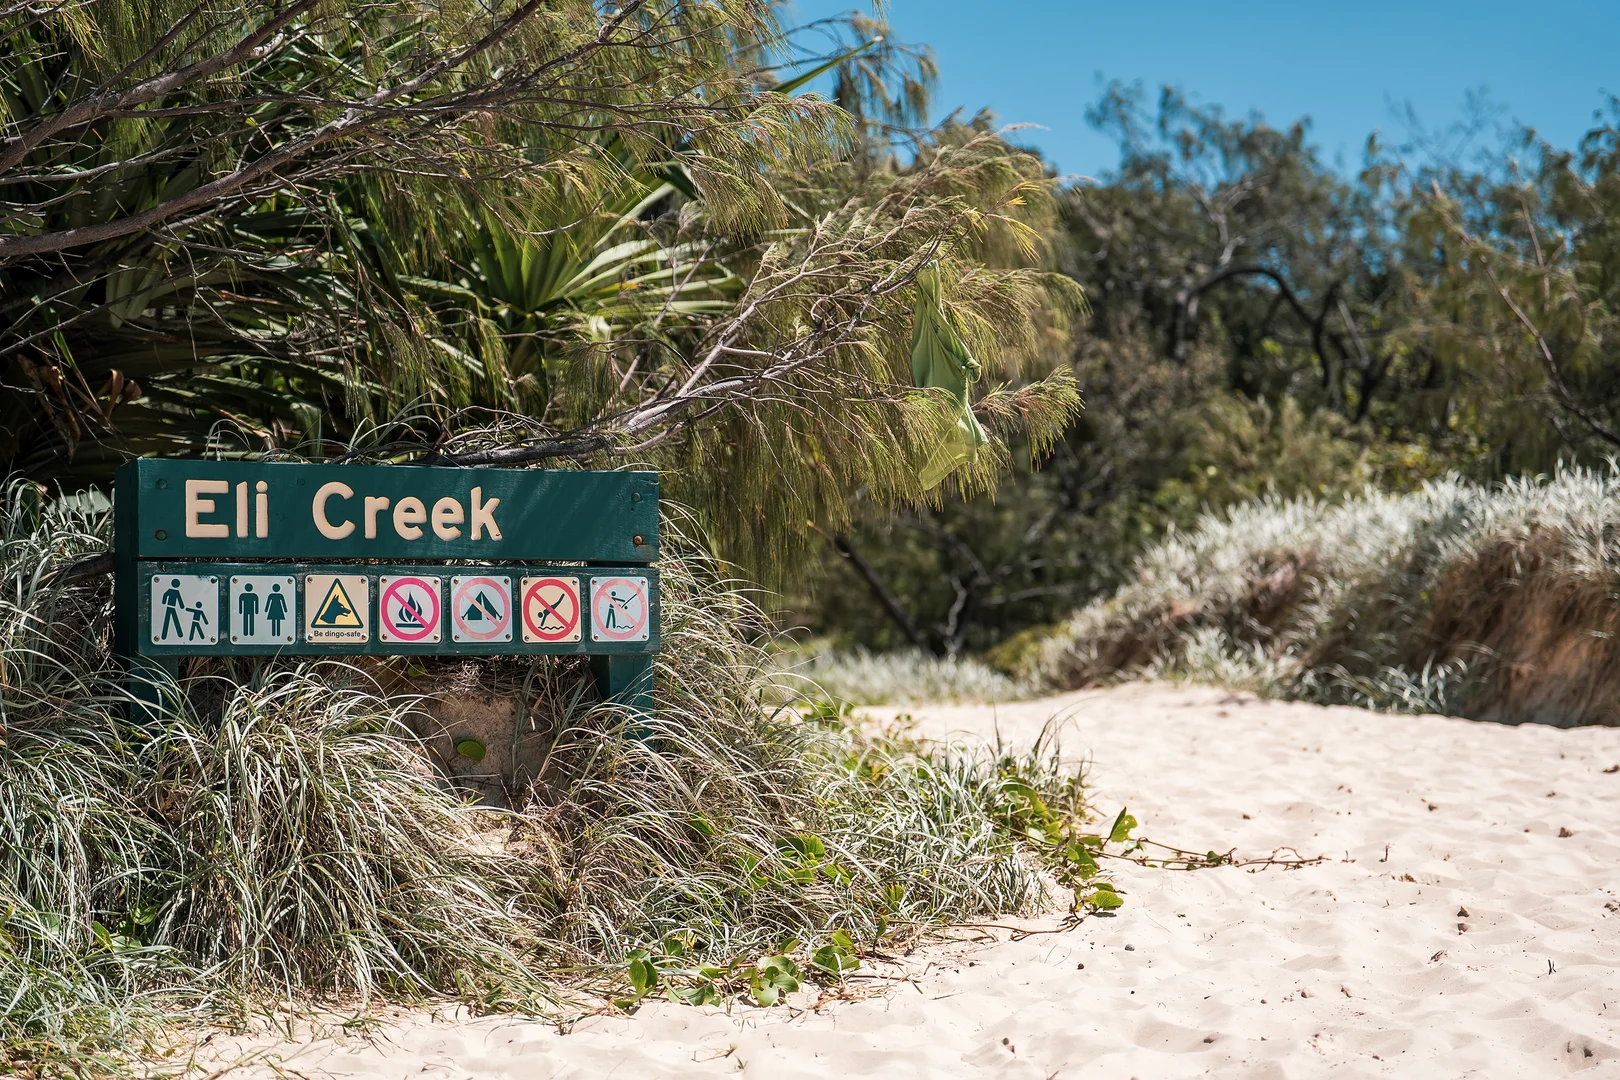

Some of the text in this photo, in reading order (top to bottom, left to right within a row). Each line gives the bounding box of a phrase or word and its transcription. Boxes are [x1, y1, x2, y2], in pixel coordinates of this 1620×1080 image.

[185, 479, 503, 541] Eli Creek
[325, 630, 361, 638] dingo-safe
